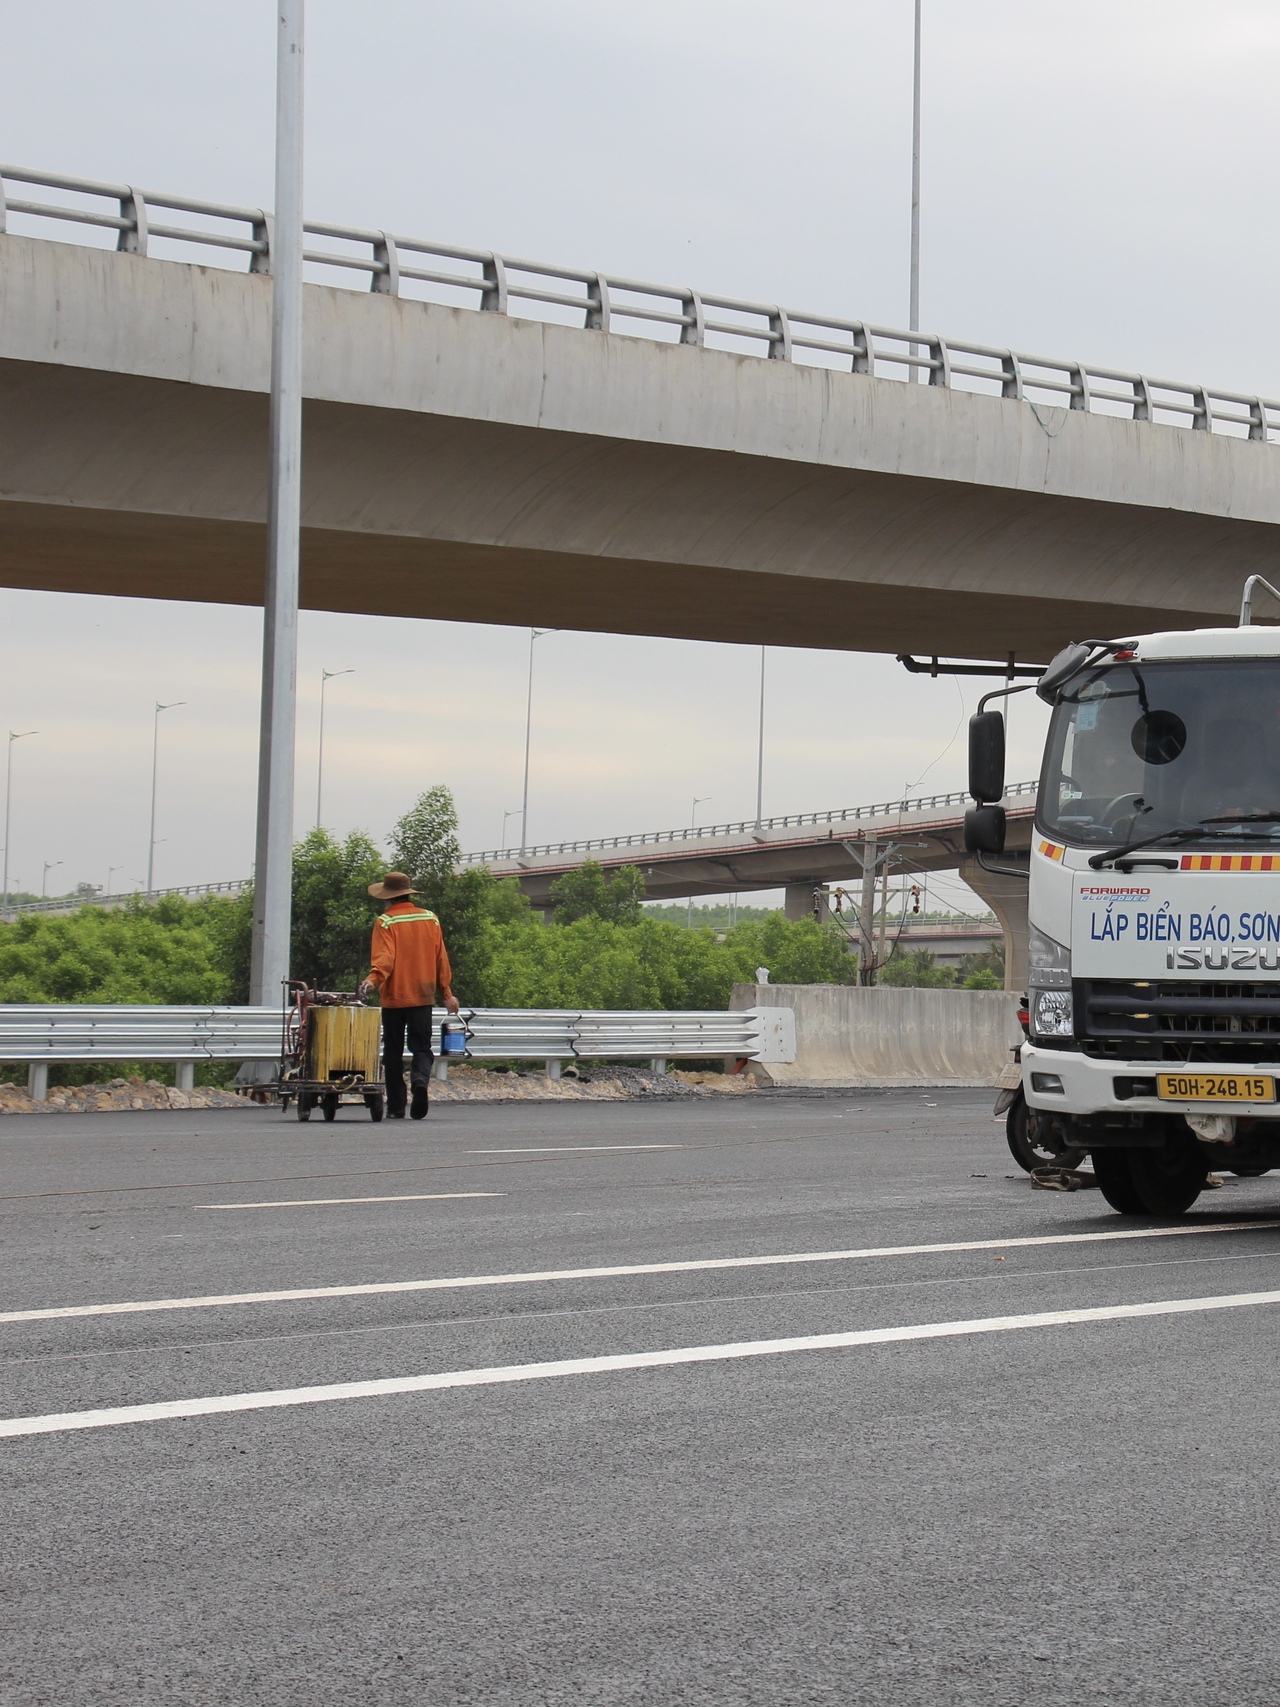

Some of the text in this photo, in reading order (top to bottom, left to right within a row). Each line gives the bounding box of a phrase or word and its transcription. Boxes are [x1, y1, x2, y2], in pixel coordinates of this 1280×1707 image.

[1080, 887, 1151, 895] FORWARD
[1091, 902, 1129, 941] LẮP
[1136, 901, 1182, 941] BIỂN
[1167, 1078, 1264, 1097] 50H-248.15
